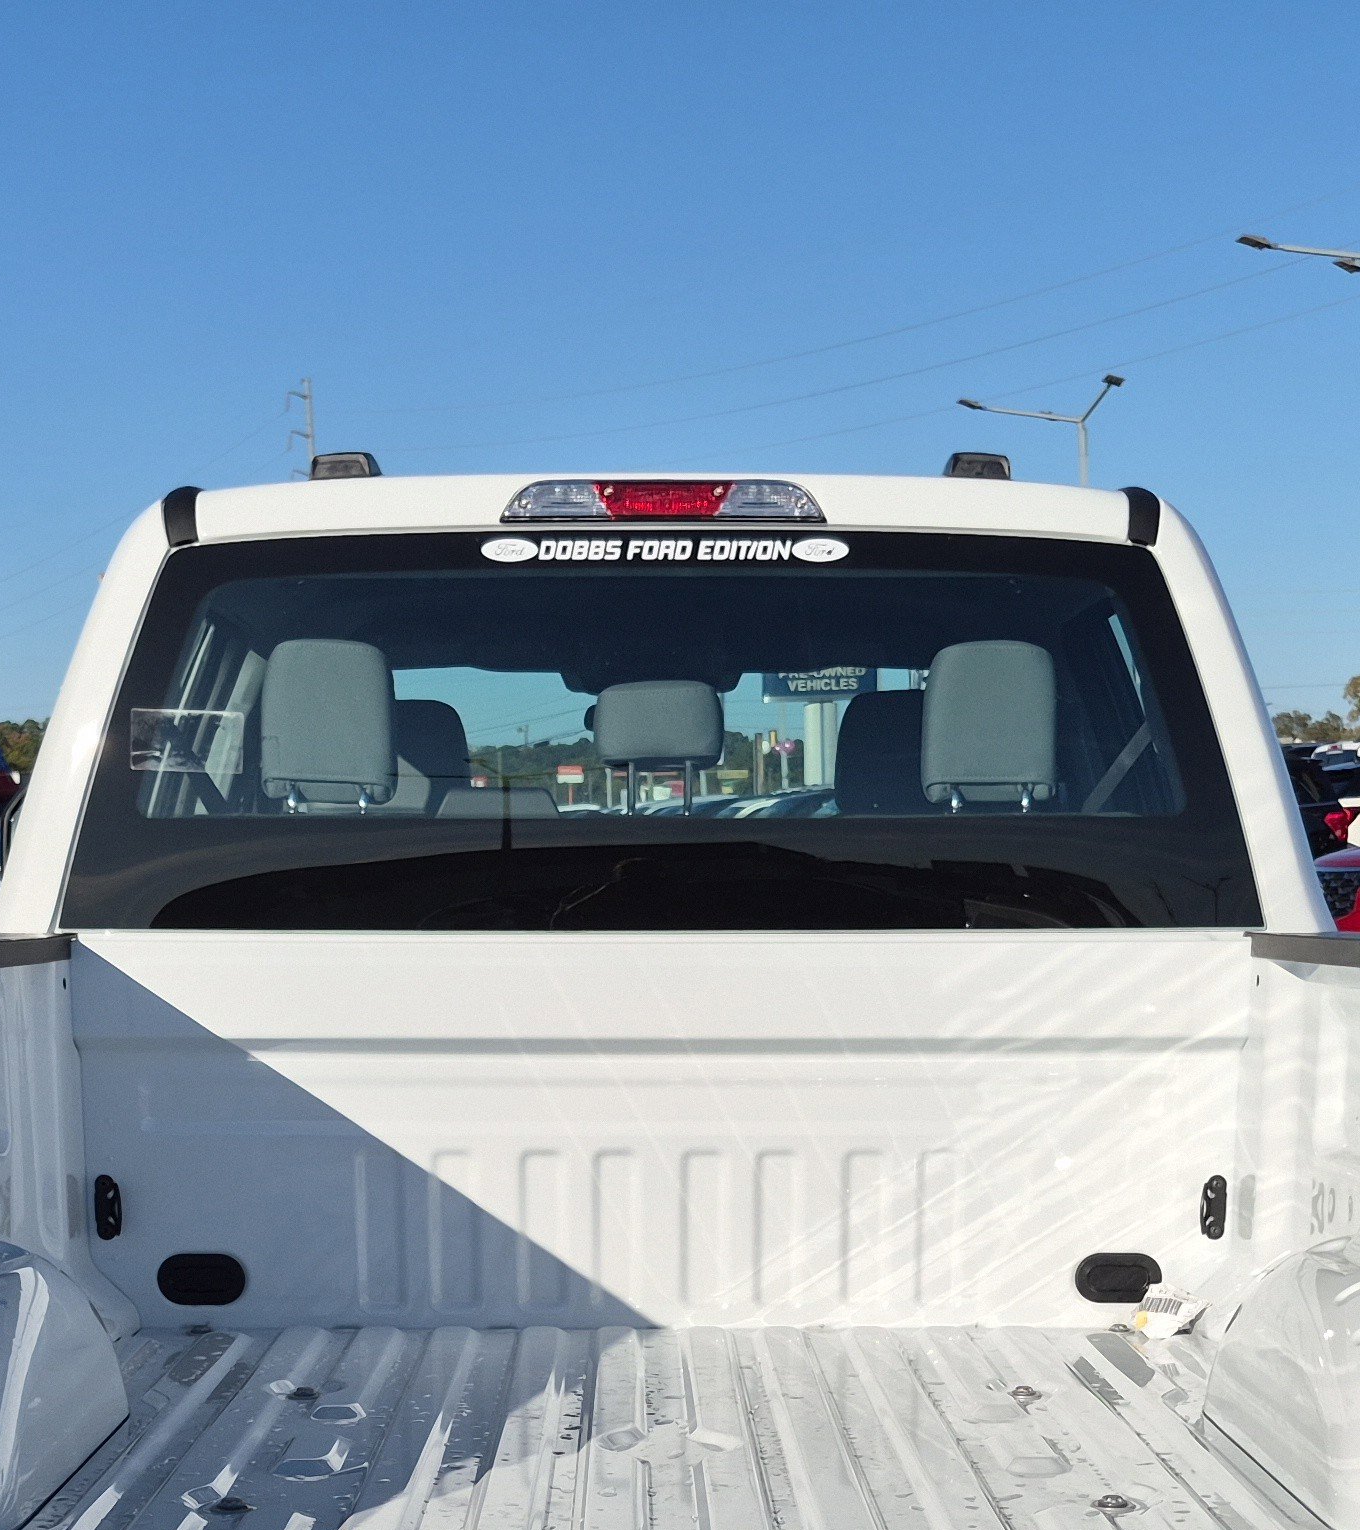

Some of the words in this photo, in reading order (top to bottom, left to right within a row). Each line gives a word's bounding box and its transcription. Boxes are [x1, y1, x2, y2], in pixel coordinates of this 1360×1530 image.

[538, 540, 622, 561] DOBBS
[626, 540, 693, 561] FORD
[696, 540, 791, 561] EDITION
[787, 678, 859, 692] VEHICLES
